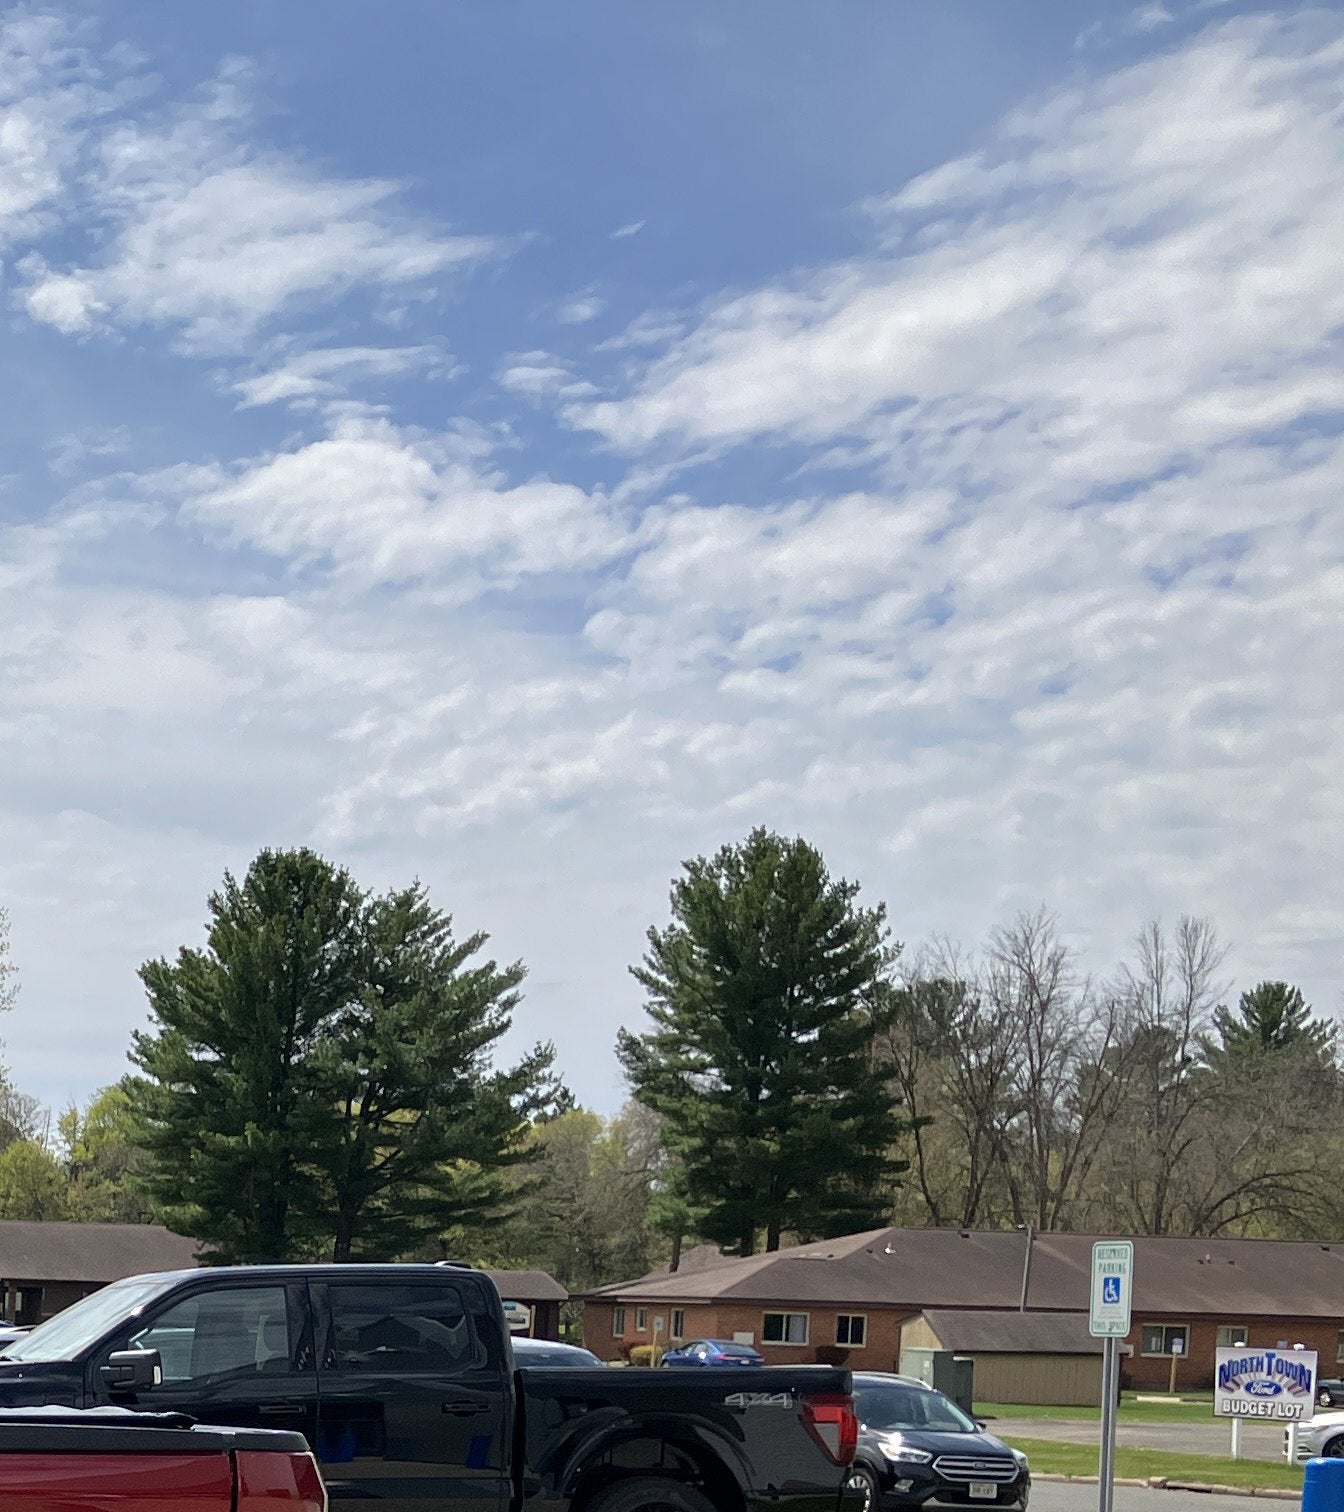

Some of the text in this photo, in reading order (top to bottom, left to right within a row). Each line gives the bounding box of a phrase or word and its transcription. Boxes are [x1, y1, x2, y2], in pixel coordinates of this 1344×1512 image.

[1098, 1263, 1126, 1274] PARKING
[1250, 1381, 1276, 1395] Ford
[1222, 1400, 1304, 1419] BUDGET LOT
